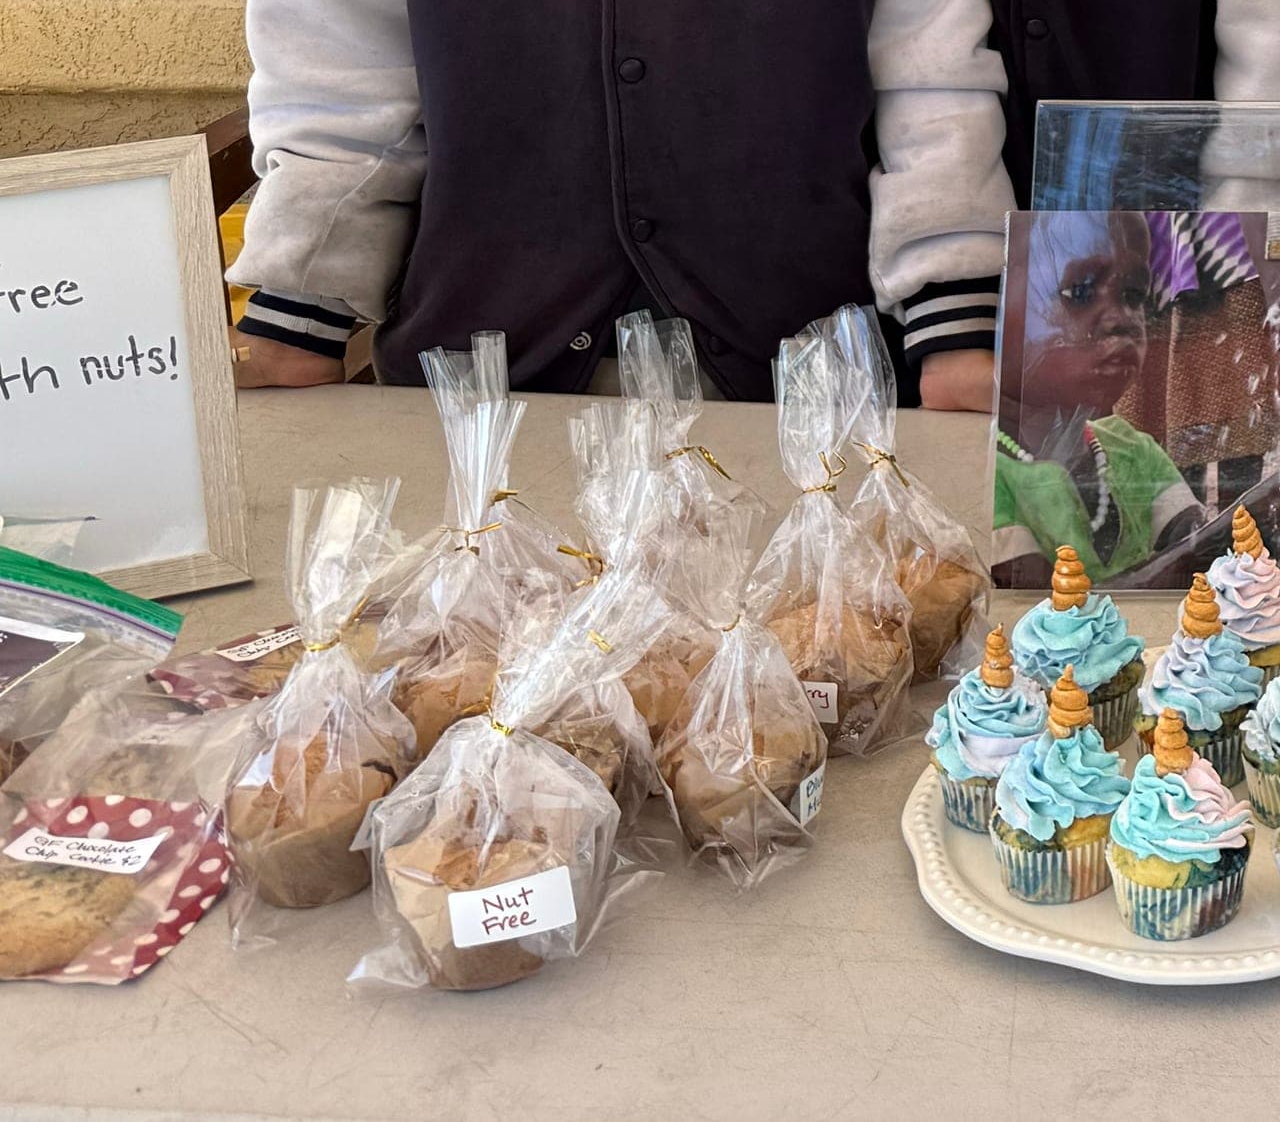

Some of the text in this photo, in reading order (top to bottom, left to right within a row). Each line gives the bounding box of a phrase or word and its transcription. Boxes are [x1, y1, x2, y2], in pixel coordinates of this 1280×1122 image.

[0, 280, 84, 313] ree
[0, 334, 178, 399] th nuts!
[25, 846, 142, 867] Chip Cookie $2
[66, 841, 137, 856] Chocolate
[481, 886, 534, 914] Nut
[481, 910, 537, 935] Free
